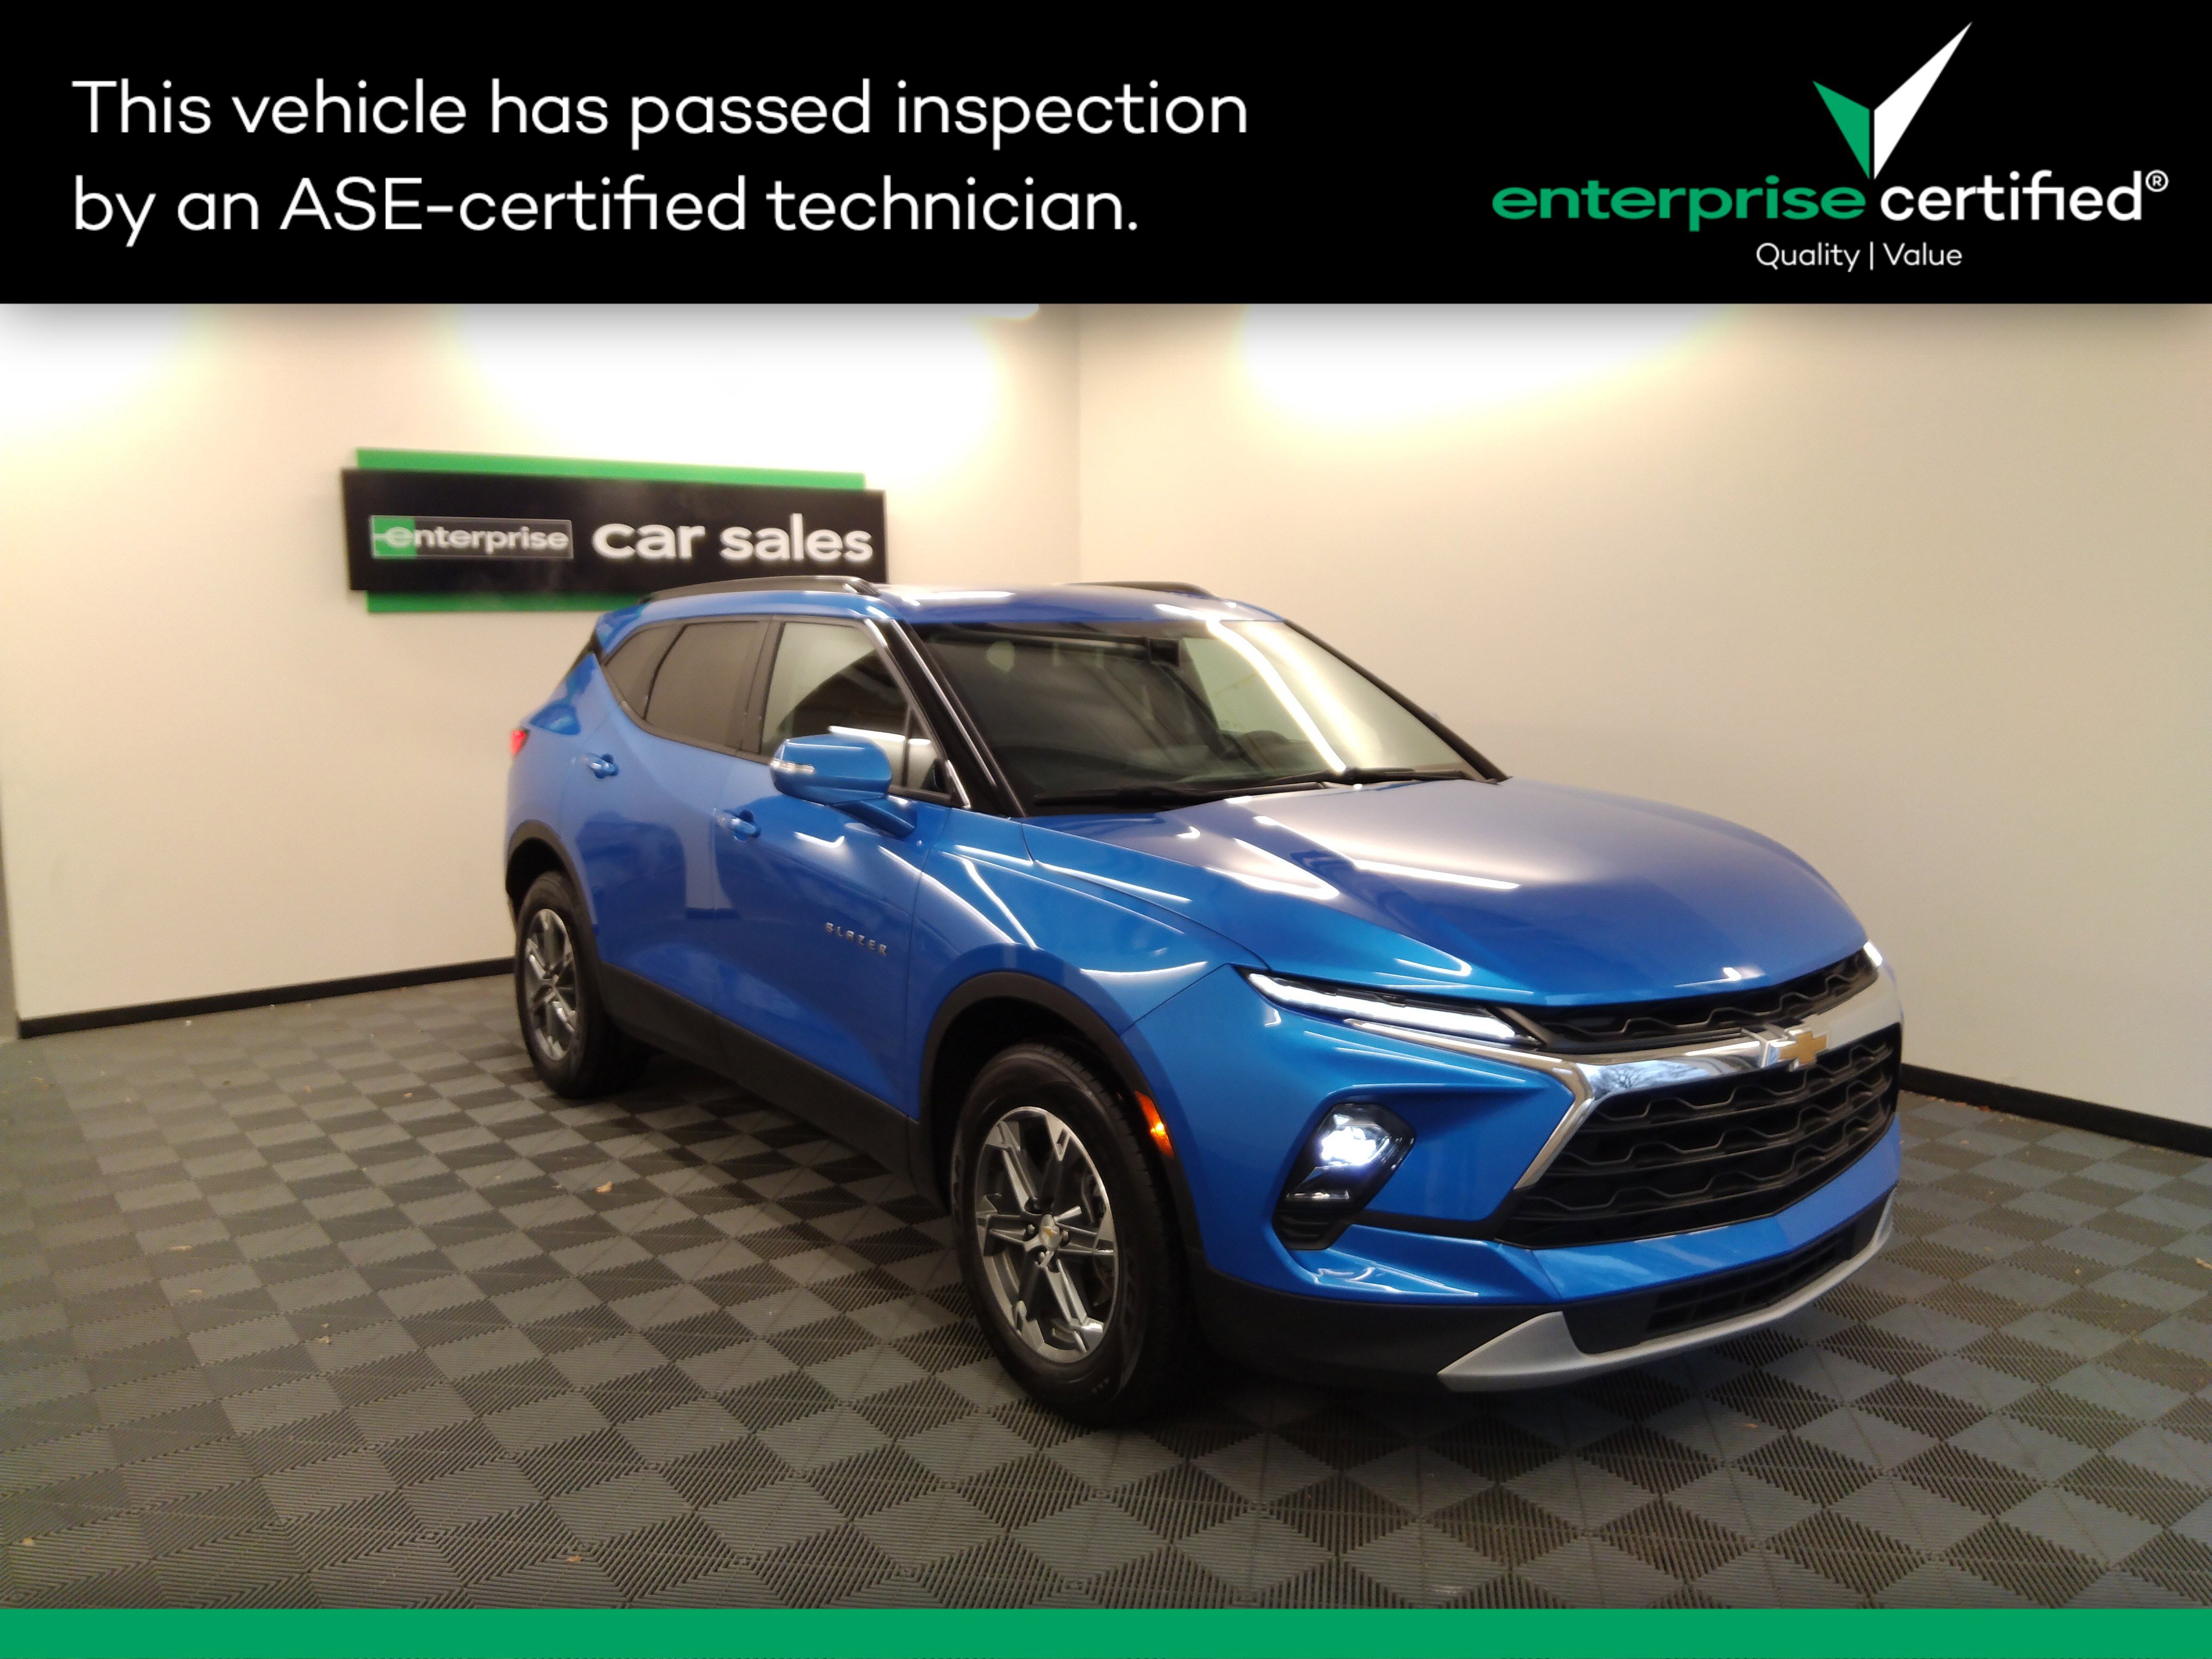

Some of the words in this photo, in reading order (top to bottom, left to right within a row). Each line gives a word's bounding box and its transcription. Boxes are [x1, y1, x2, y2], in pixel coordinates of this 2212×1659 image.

[374, 526, 569, 555] enterprise
[592, 523, 705, 559] car
[720, 513, 873, 563] sales
[825, 921, 887, 956] BLAZER
